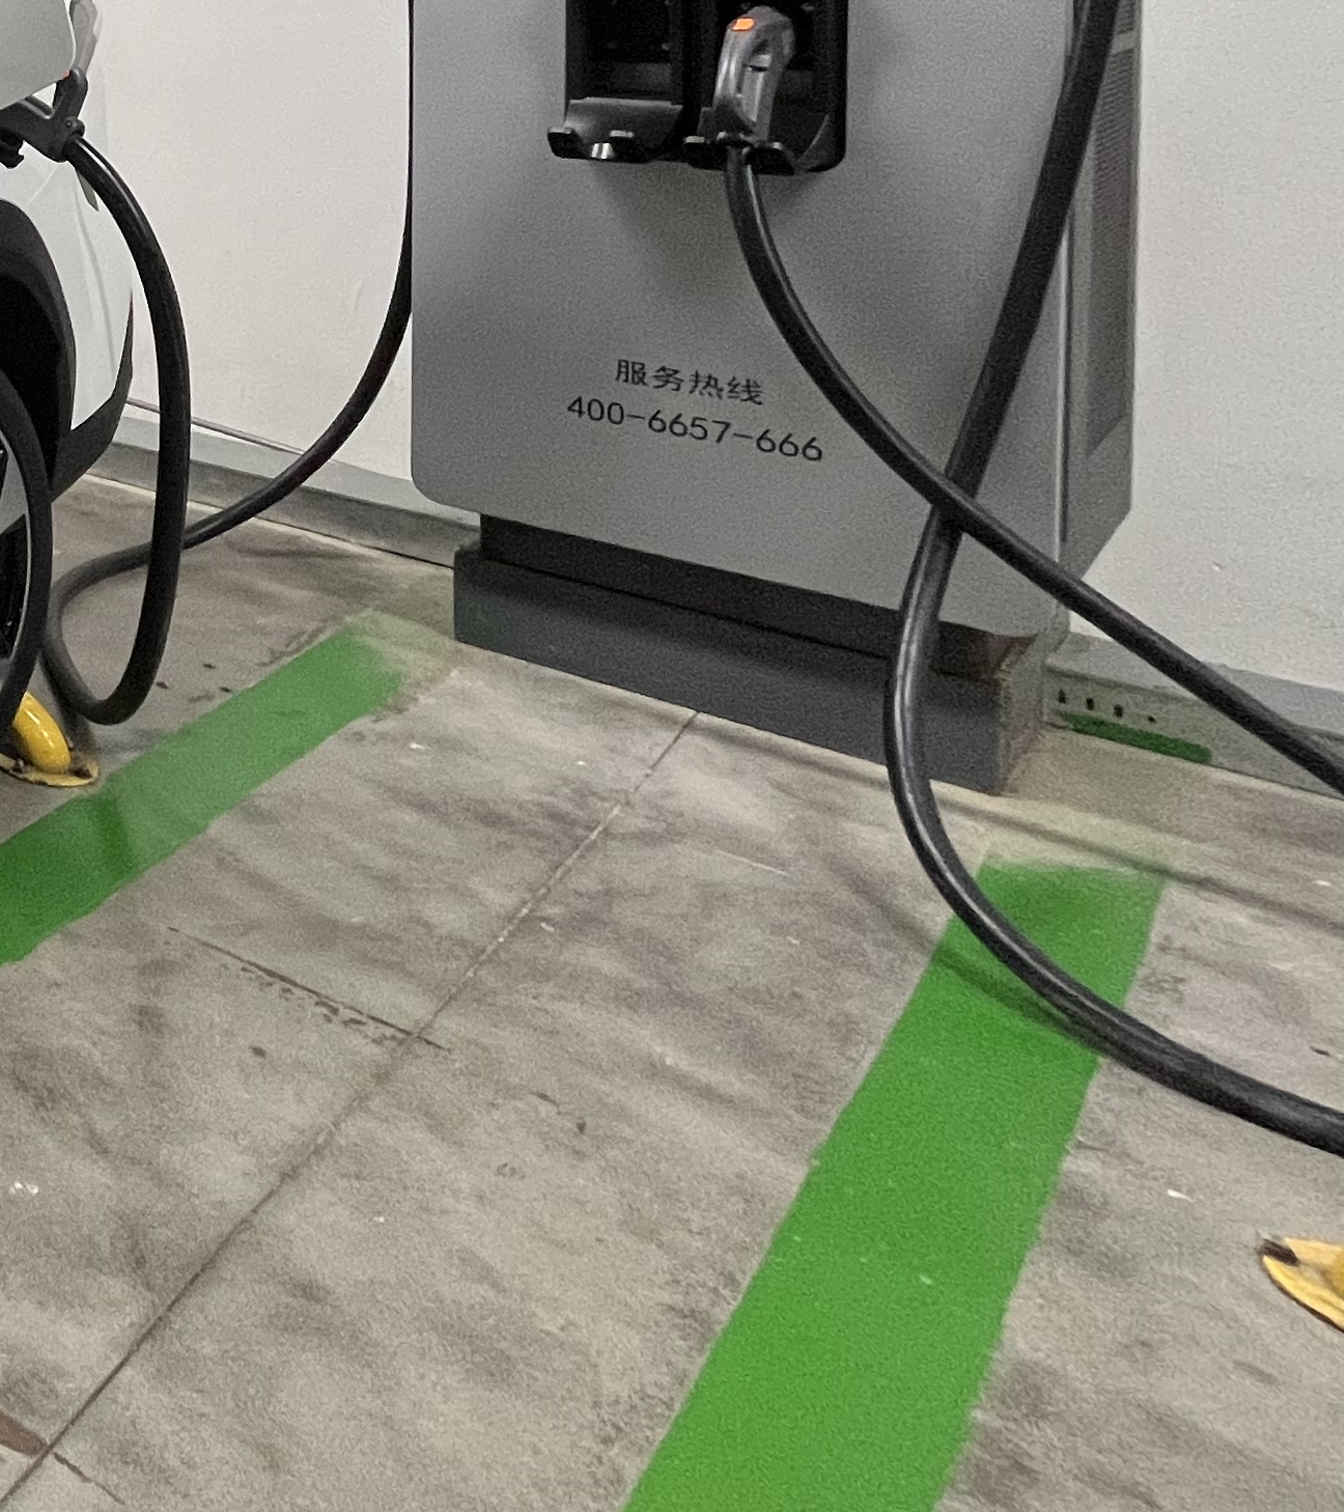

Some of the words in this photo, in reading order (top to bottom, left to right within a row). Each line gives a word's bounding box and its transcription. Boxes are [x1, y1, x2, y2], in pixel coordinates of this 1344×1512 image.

[615, 359, 763, 405] 服务热线
[567, 395, 823, 462] 400-6657-666
